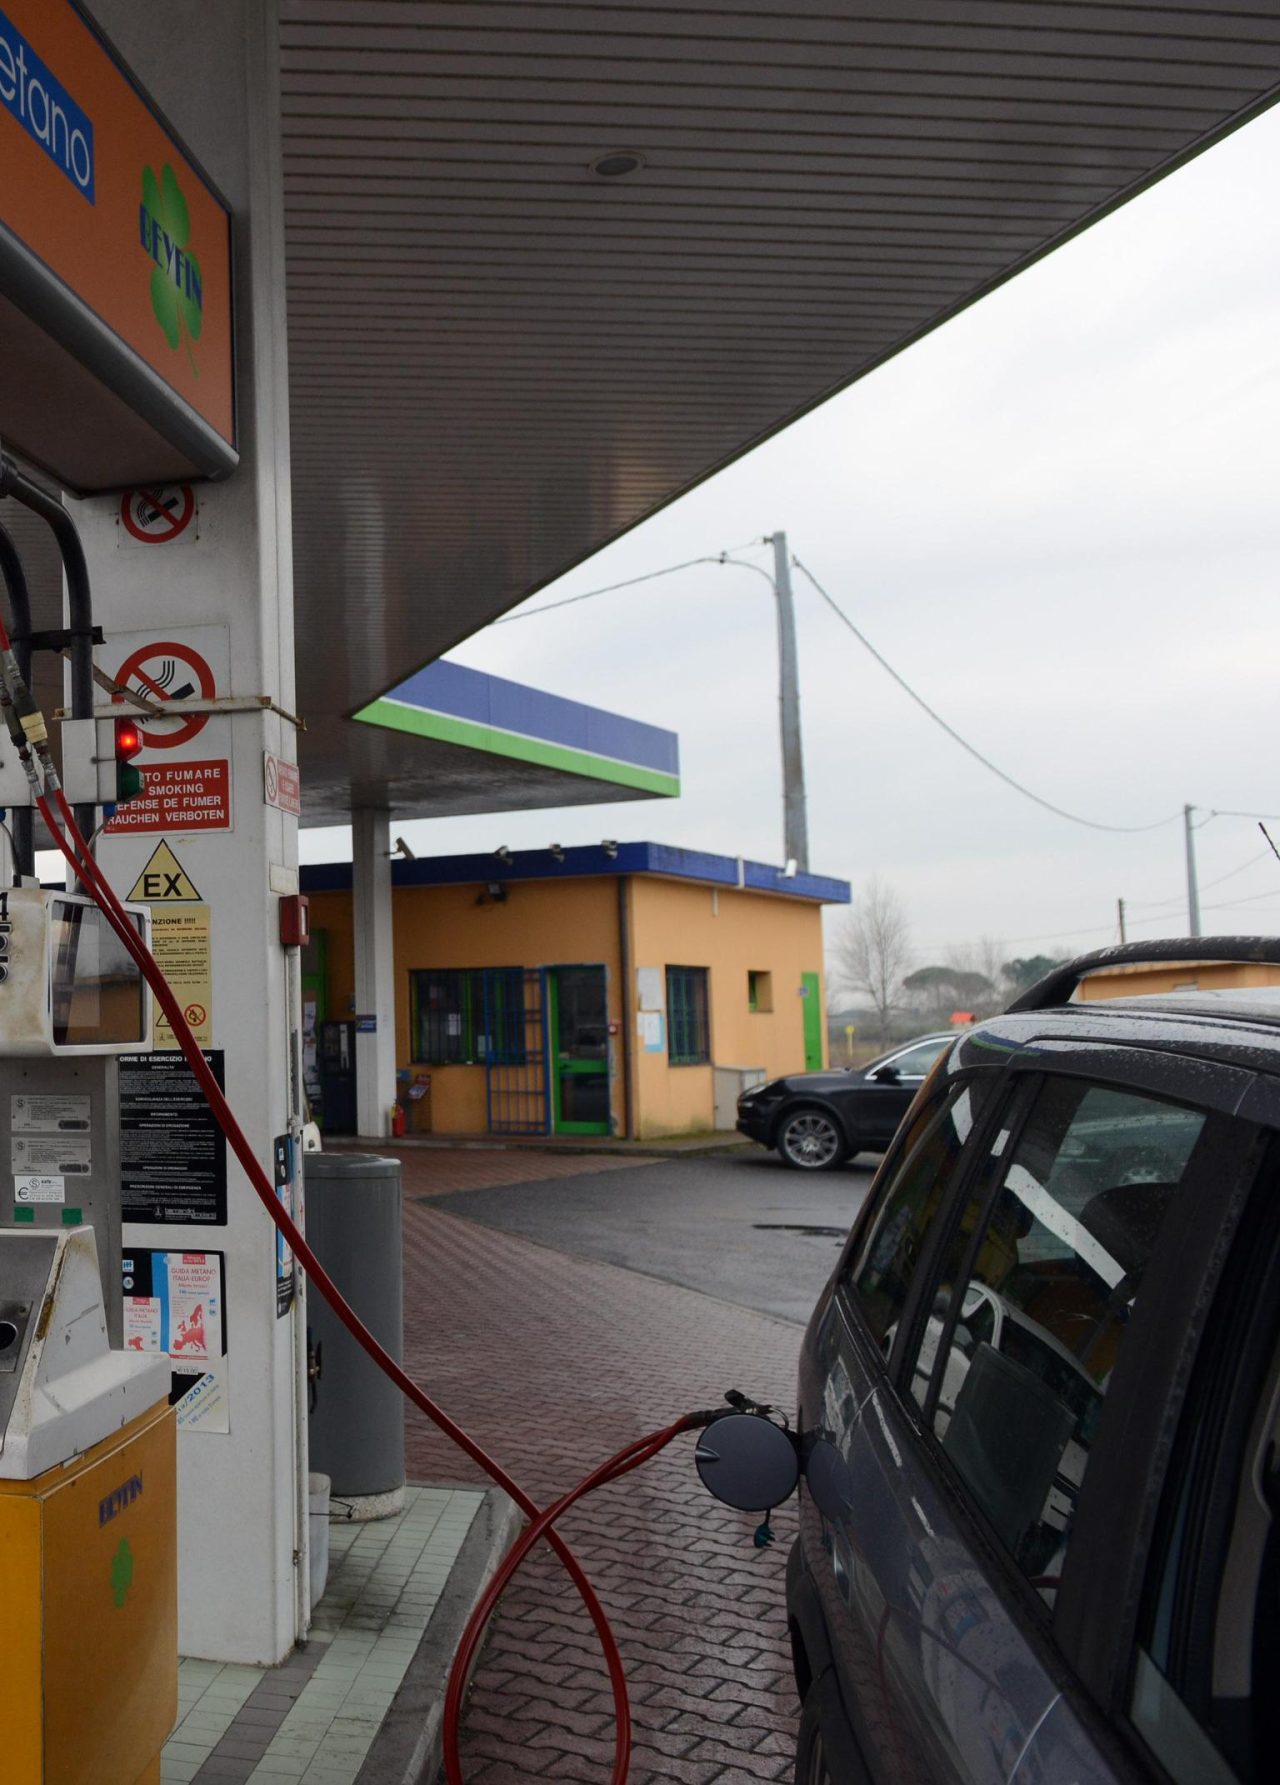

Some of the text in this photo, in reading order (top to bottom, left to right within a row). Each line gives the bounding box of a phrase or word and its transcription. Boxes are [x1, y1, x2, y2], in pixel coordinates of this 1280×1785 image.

[139, 202, 202, 312] BEYFIN
[166, 768, 221, 781] FUMARE
[148, 783, 204, 796] SMOKING
[117, 796, 221, 811] EFENSE DE FUMER
[165, 809, 224, 822] VERBOTEN
[144, 873, 183, 897] EX
